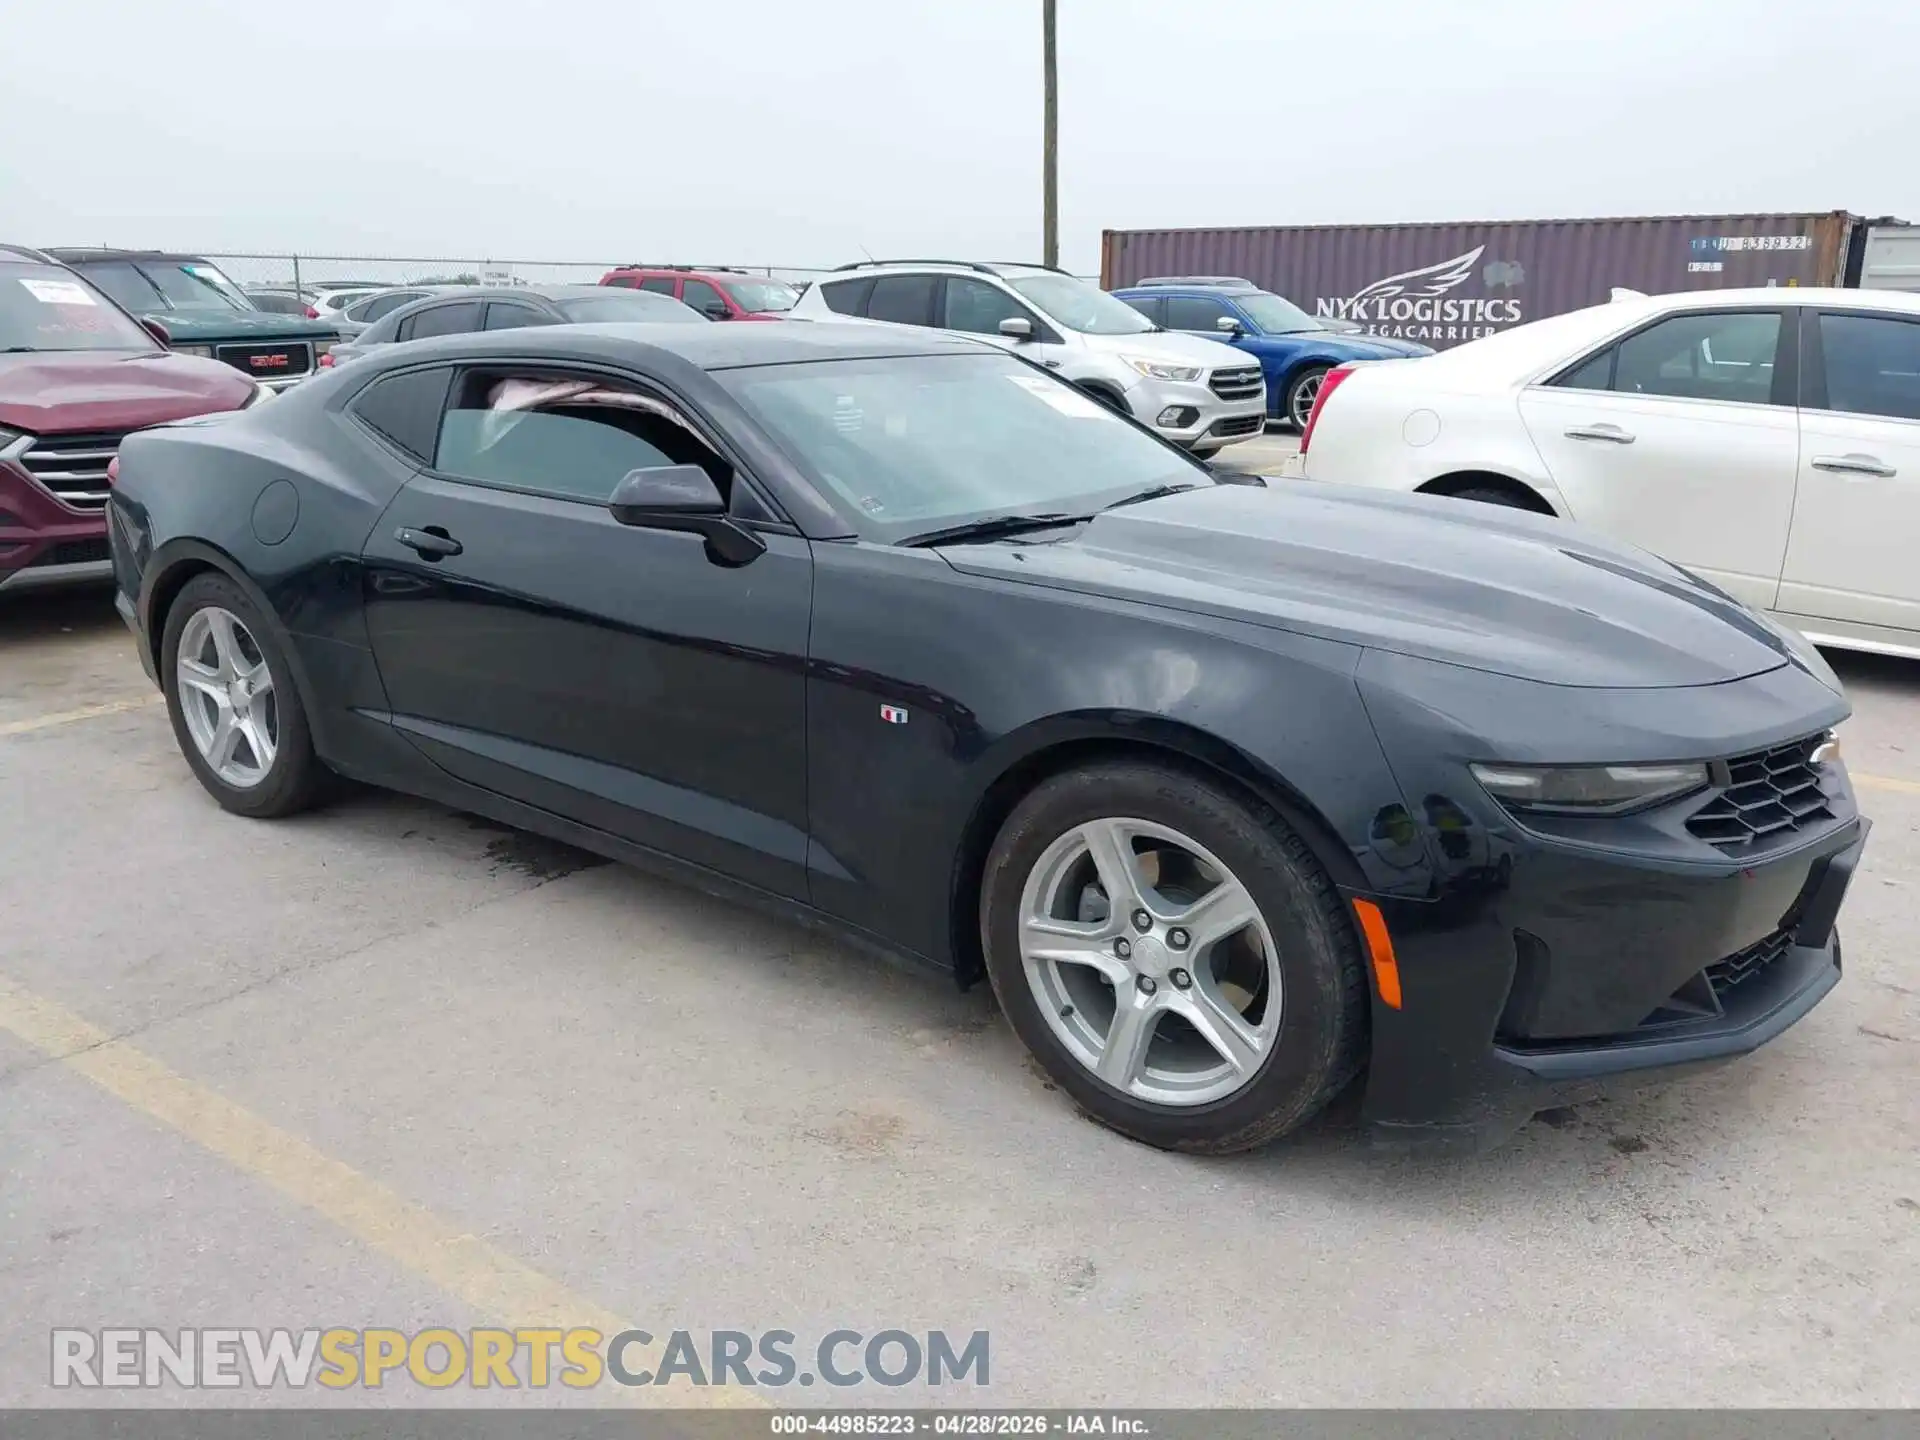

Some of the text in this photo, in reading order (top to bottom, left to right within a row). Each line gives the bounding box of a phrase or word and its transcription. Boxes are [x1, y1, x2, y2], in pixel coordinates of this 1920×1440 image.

[1316, 297, 1521, 322] NYK LOGISTICS
[1368, 324, 1496, 340] EGACARRIER
[250, 354, 288, 367] GMC
